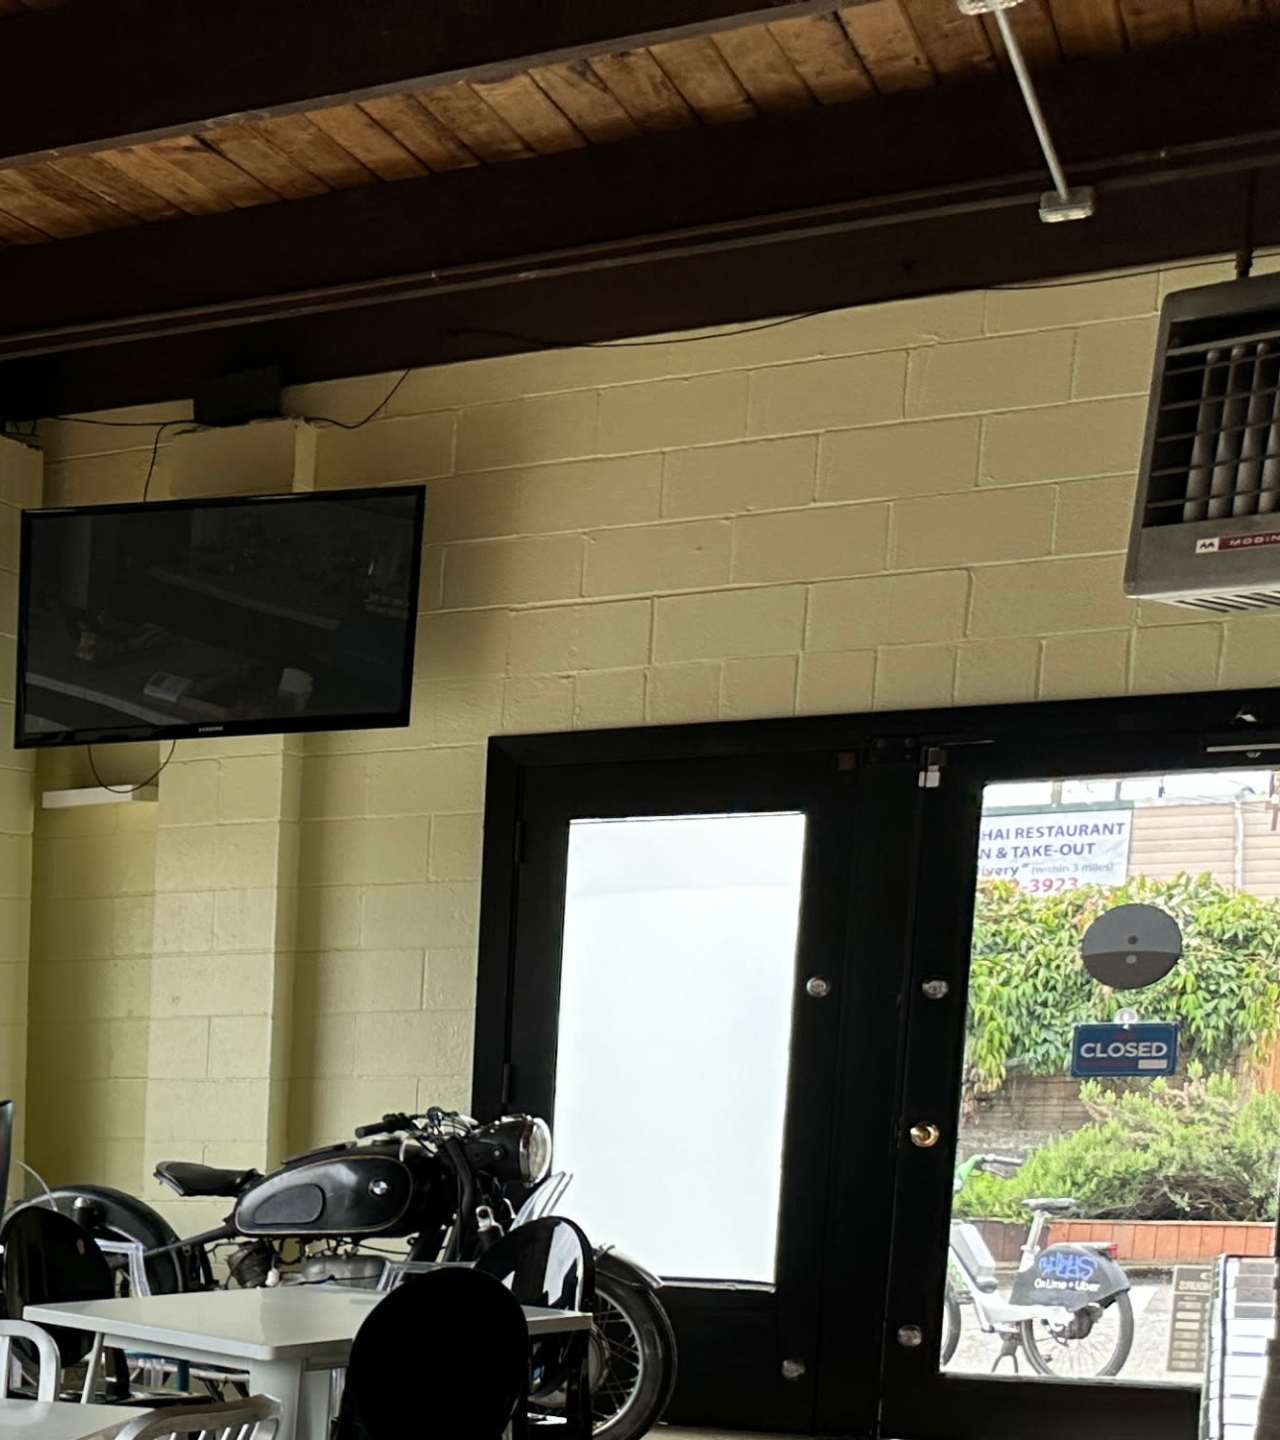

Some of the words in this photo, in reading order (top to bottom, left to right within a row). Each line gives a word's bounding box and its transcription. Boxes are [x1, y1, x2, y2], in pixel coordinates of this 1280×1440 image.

[1015, 823, 1125, 840] RESTAURANT
[996, 847, 1007, 859] &
[1011, 843, 1096, 859] TAKE-OUT
[1080, 1042, 1168, 1058] CLOSED
